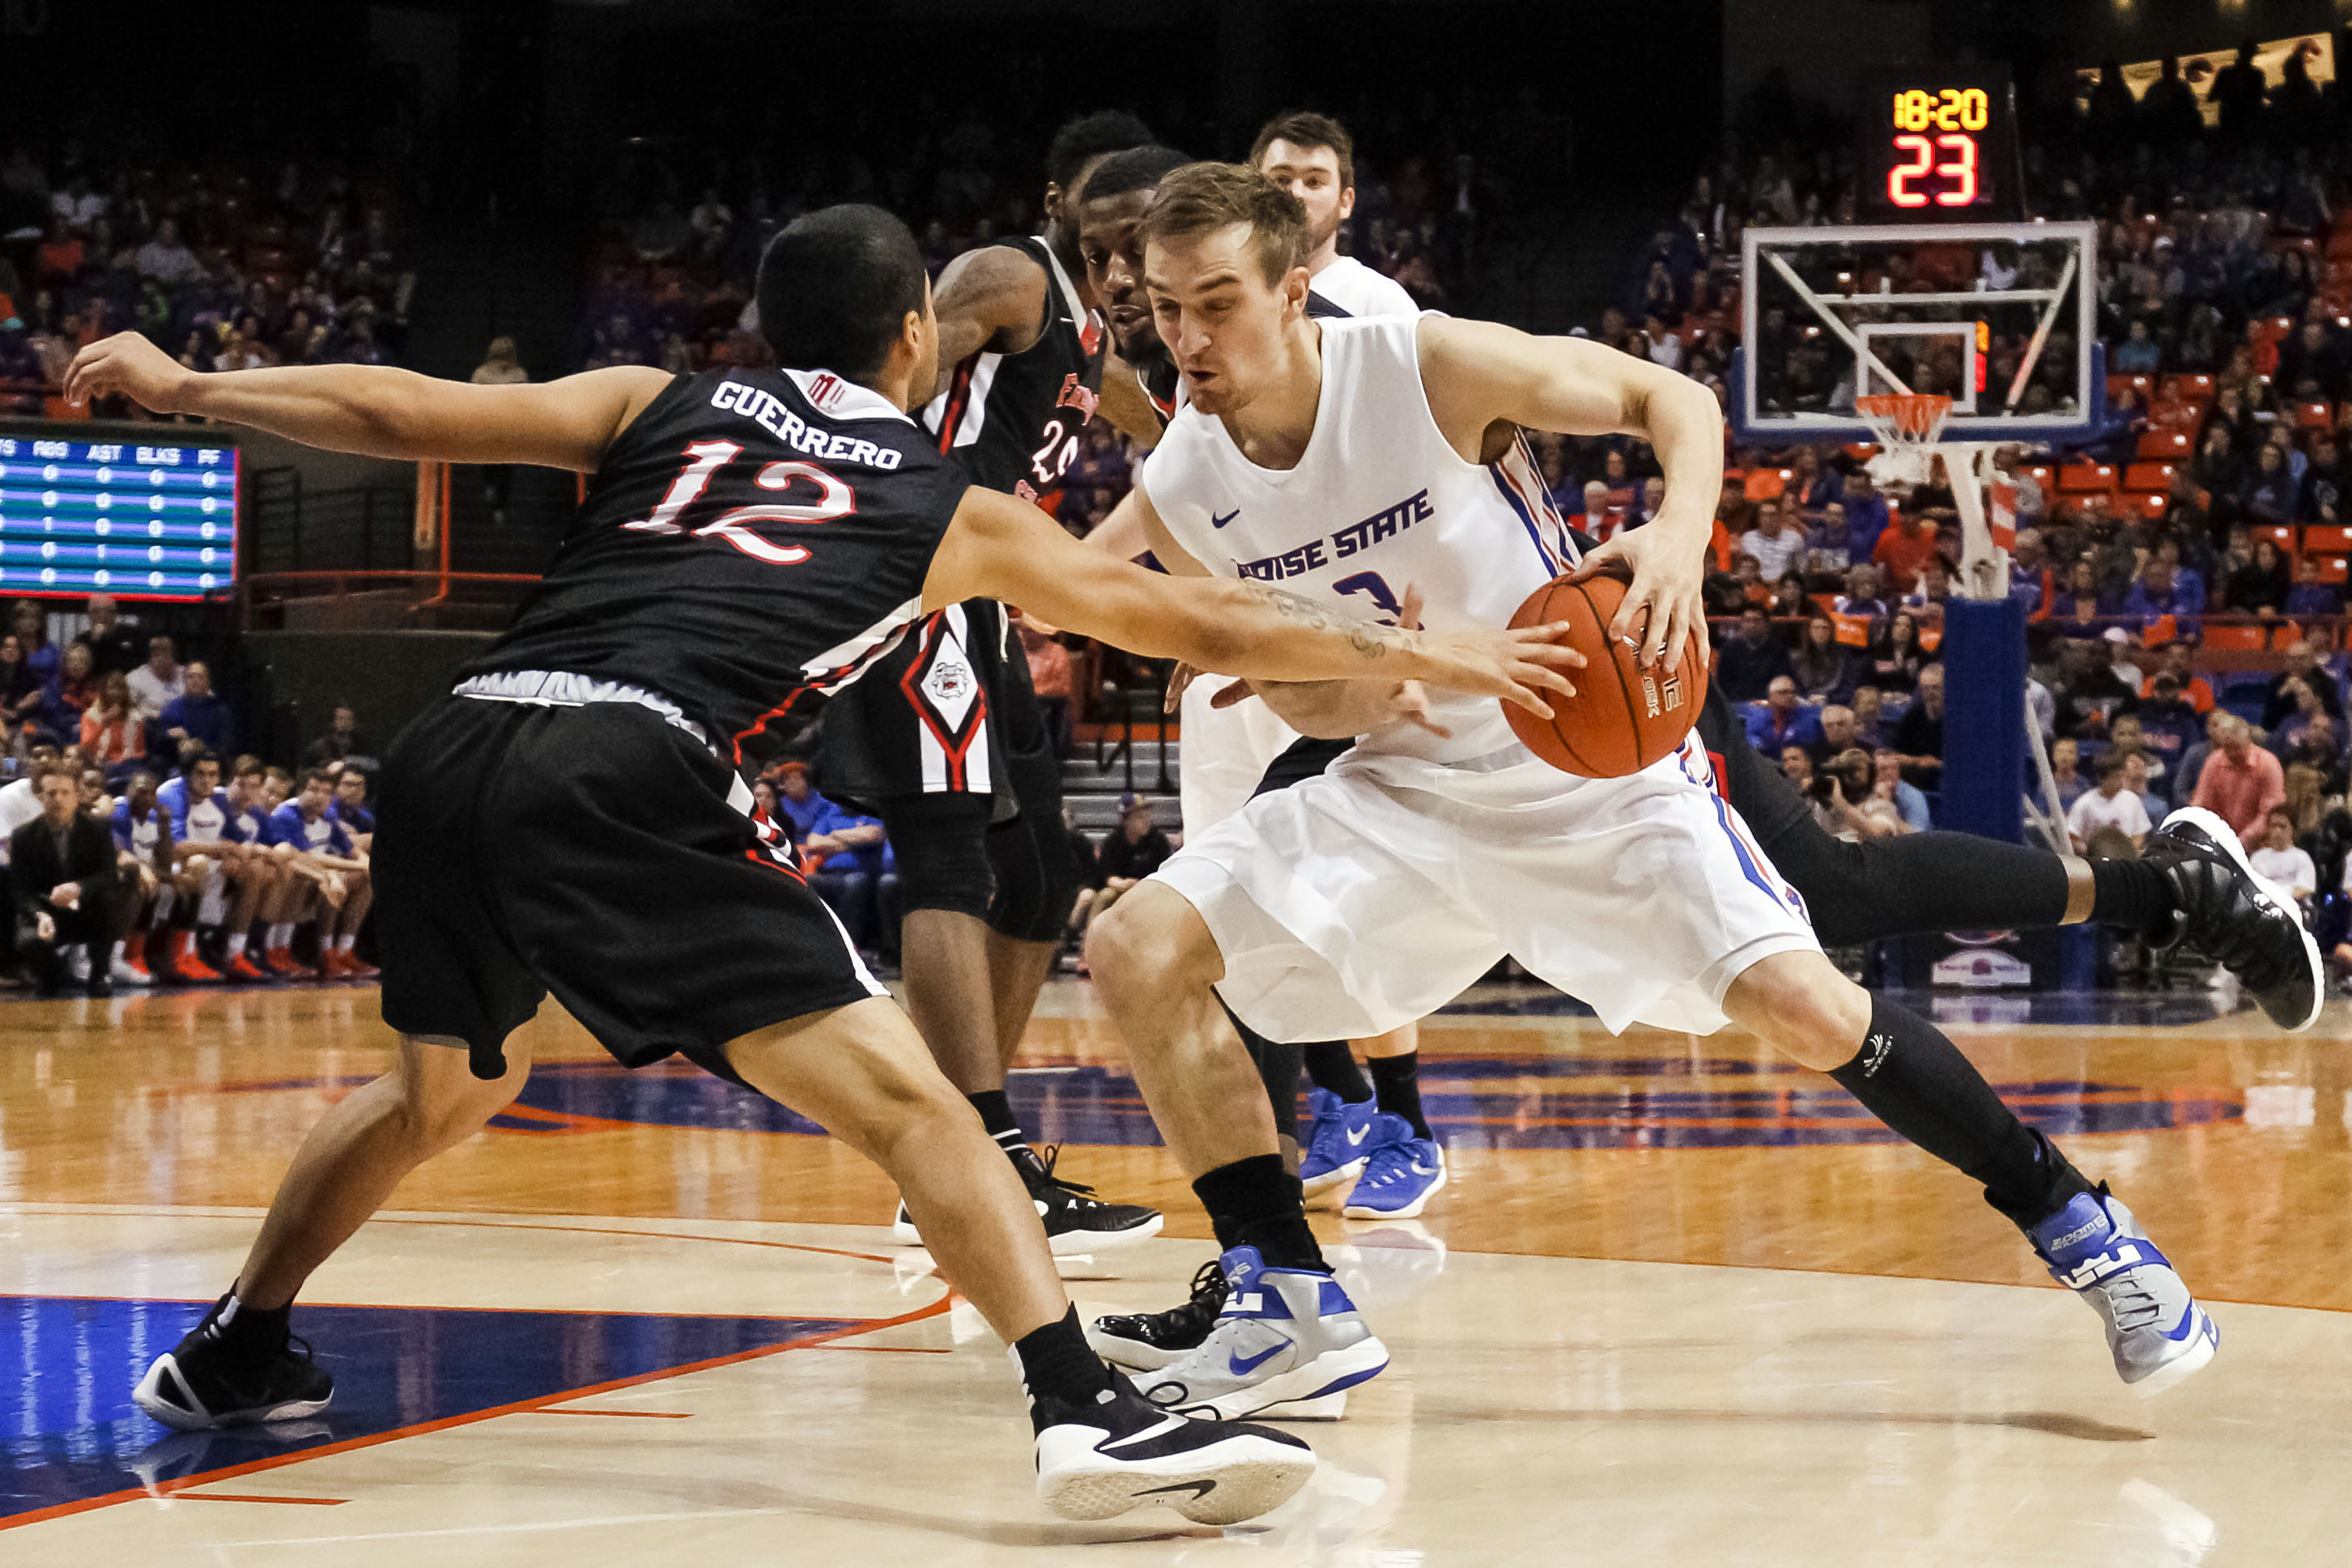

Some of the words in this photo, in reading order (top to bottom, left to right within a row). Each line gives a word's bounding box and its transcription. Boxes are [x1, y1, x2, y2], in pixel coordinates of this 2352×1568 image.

[1894, 88, 1988, 132] 18:20
[1887, 134, 1978, 208] 23
[711, 380, 903, 470] GUERRERO
[620, 439, 858, 566] 12
[1330, 487, 1435, 559] STATE
